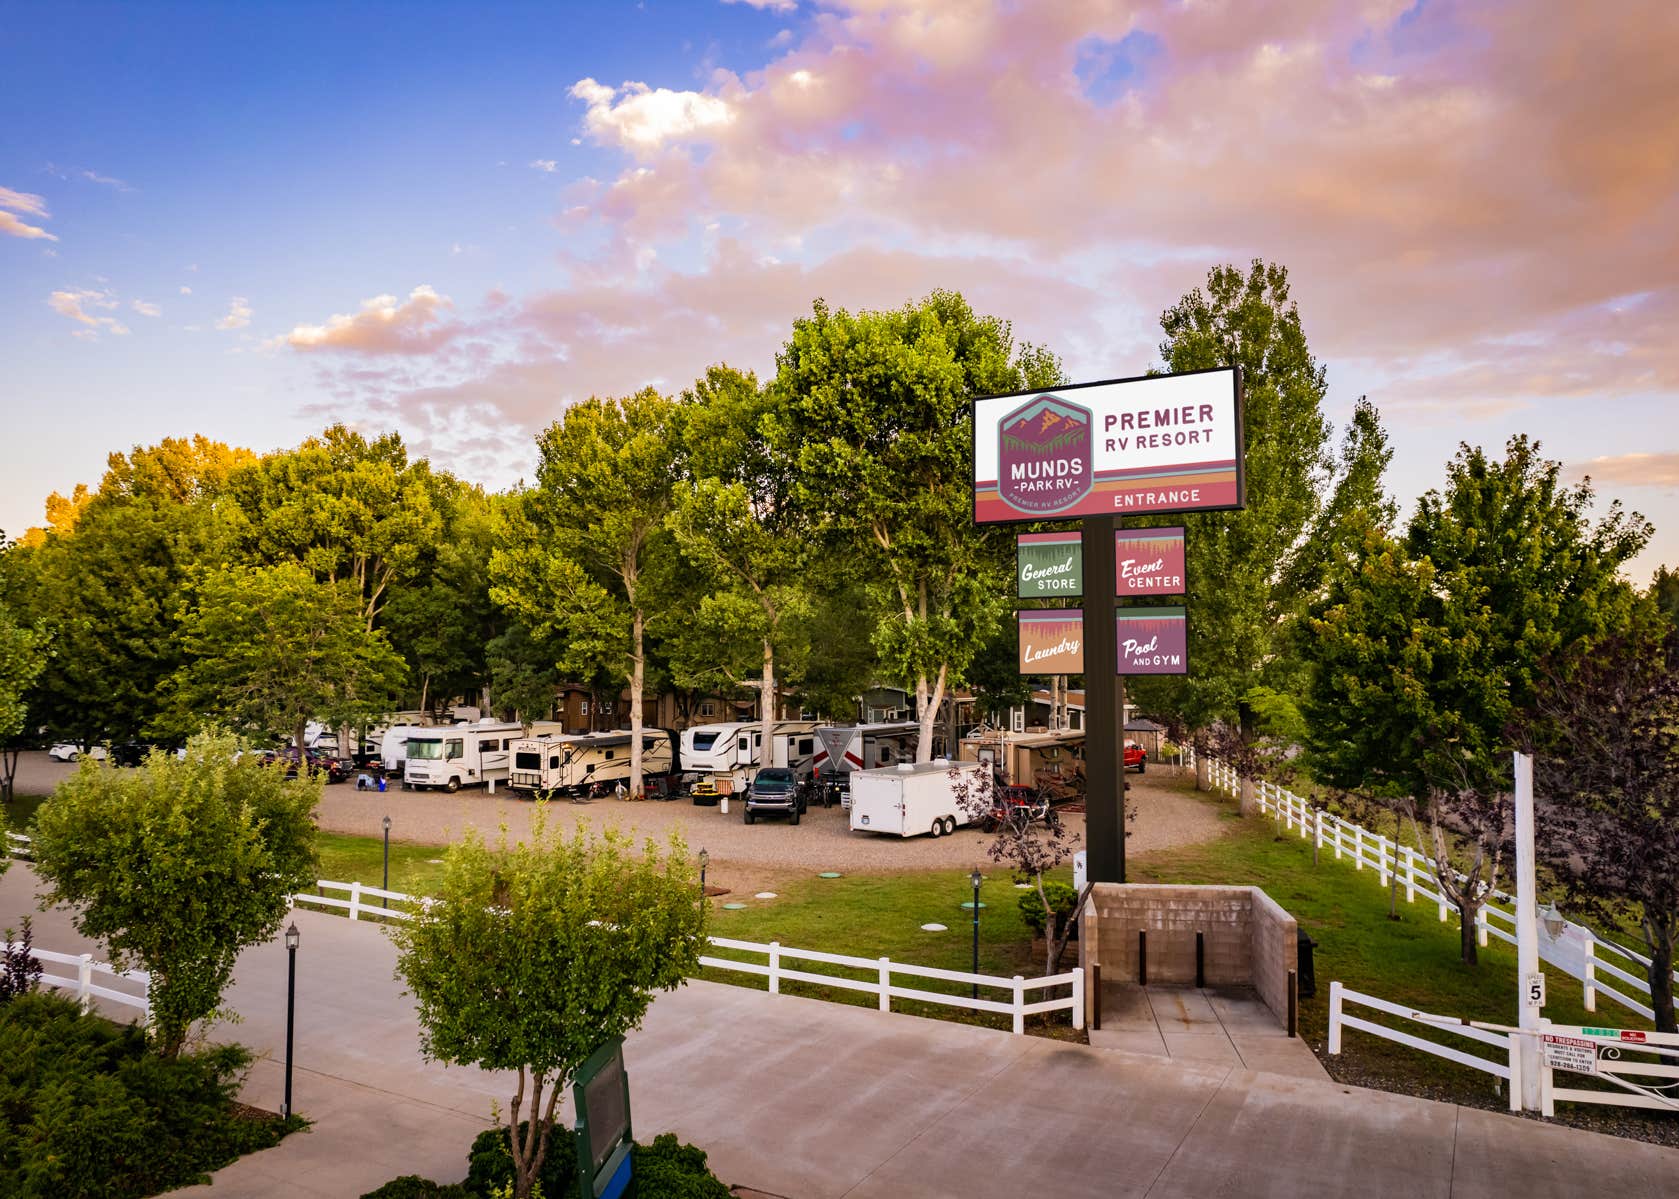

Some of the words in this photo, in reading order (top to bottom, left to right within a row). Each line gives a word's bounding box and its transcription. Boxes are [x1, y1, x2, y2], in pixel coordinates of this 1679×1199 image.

[1104, 404, 1214, 433] PREMIER
[1105, 437, 1129, 452] RV
[1136, 429, 1213, 449] RESORT
[1011, 458, 1083, 480] MUNDS
[1009, 492, 1039, 508] PREMIER
[1054, 487, 1082, 506] RESORT
[1114, 489, 1200, 508] ENTRANCE
[1021, 557, 1073, 581] General
[1120, 558, 1164, 578] Event
[1038, 578, 1076, 590] STORE
[1128, 576, 1181, 588] CENTER
[1024, 637, 1081, 663] Laundry
[1121, 635, 1158, 659] Pool
[1132, 658, 1150, 666] AND
[1153, 655, 1180, 665] GYM
[1530, 985, 1541, 1000] 5
[1545, 1035, 1554, 1043] NO
[1556, 1037, 1595, 1048] TRESPASSING
